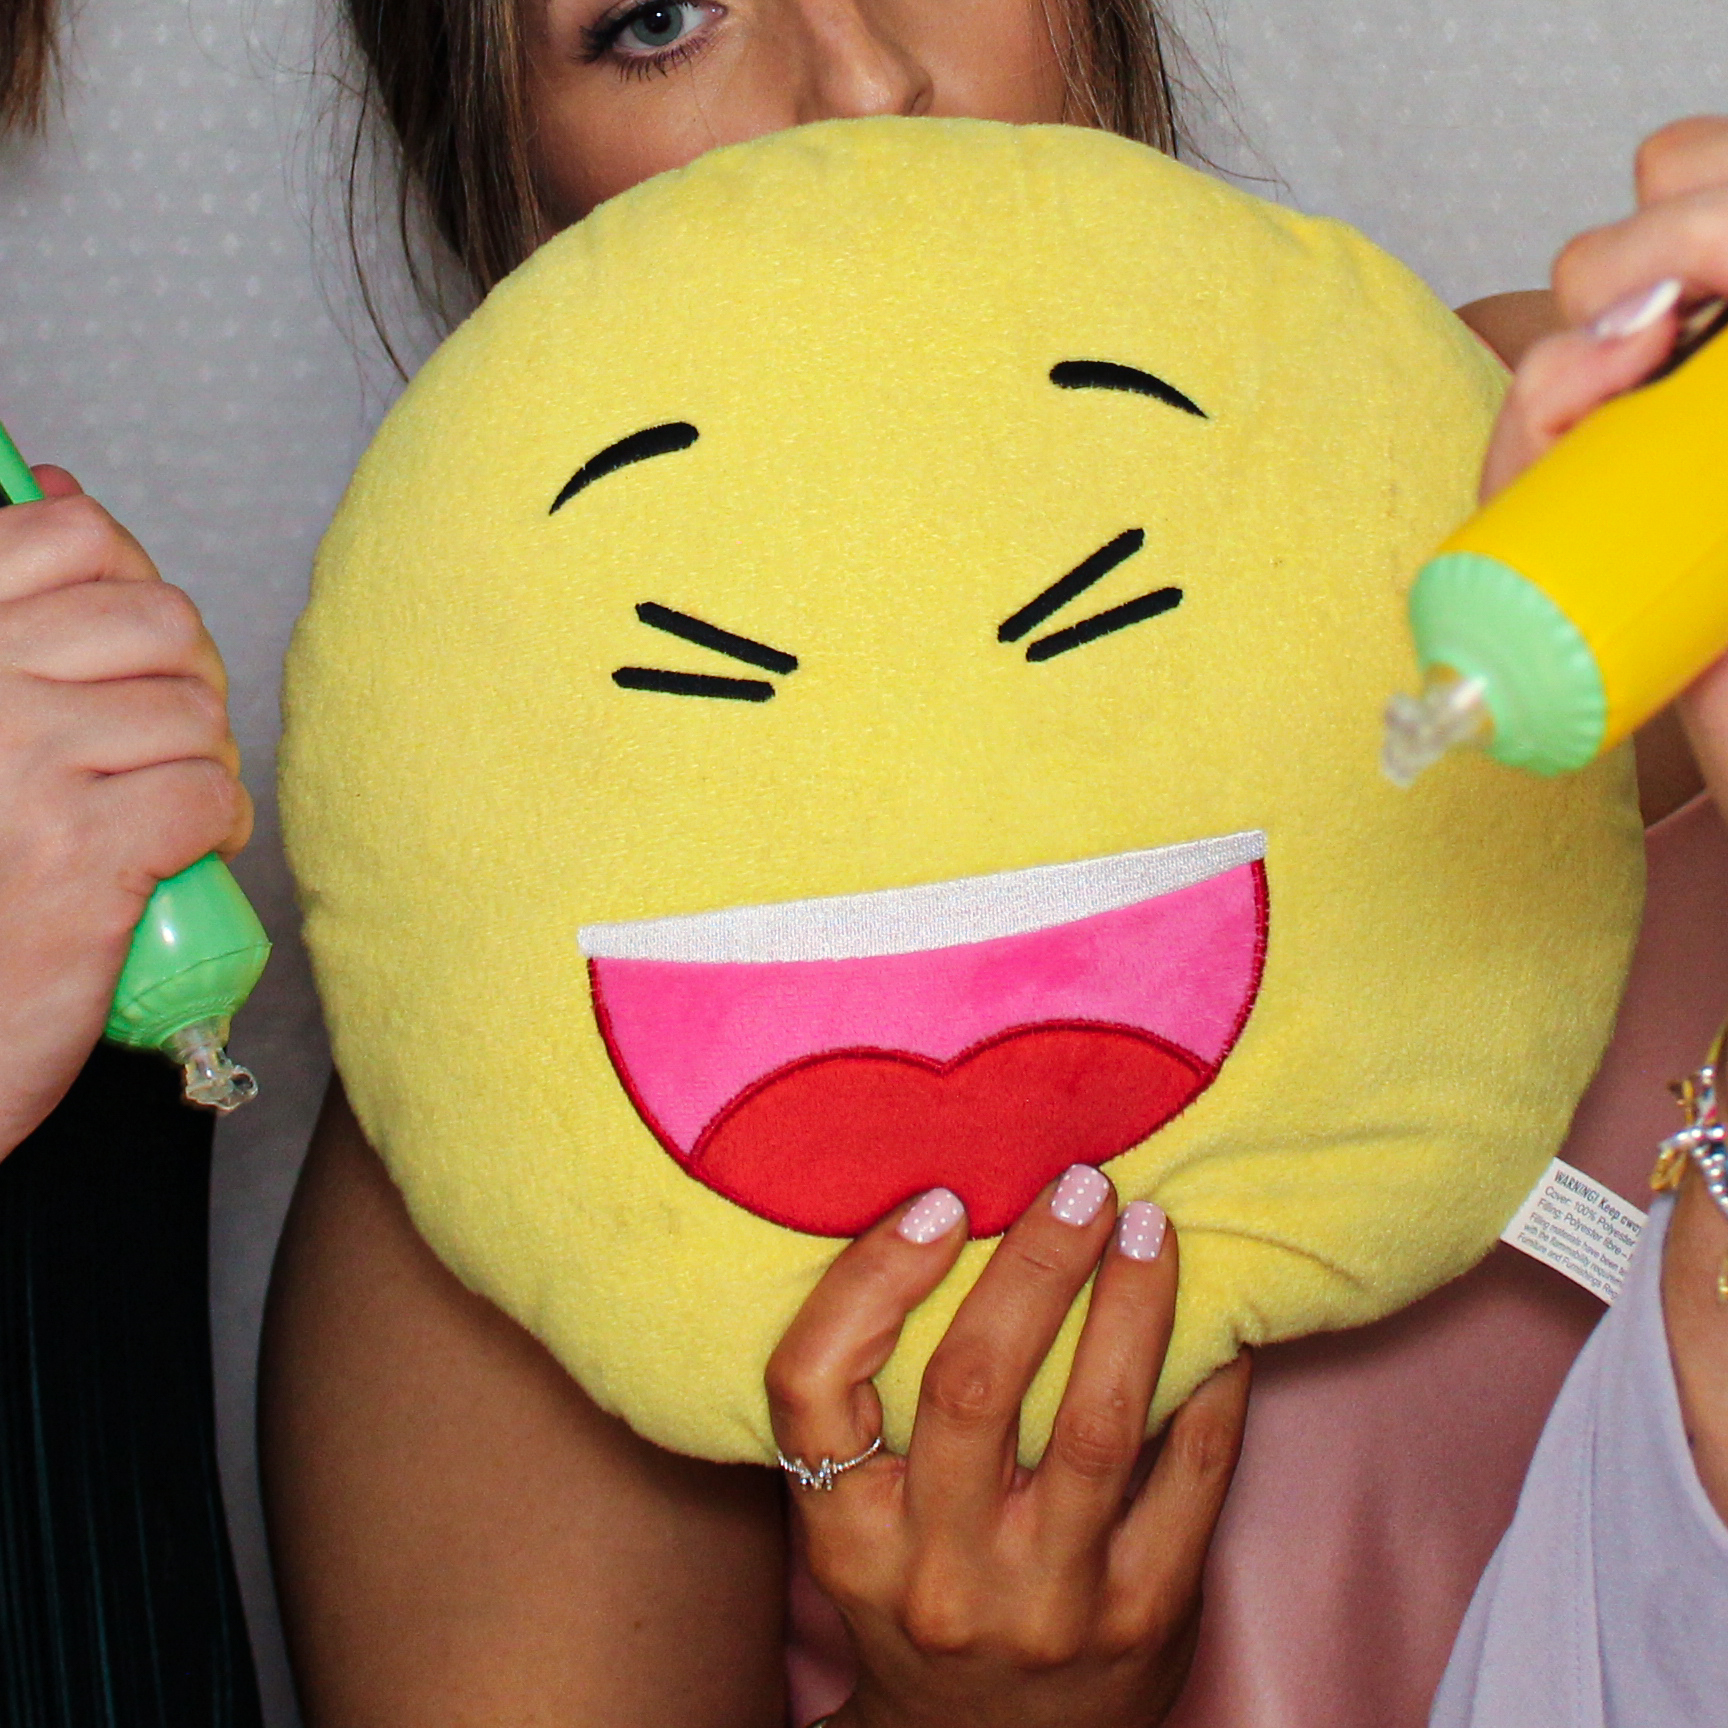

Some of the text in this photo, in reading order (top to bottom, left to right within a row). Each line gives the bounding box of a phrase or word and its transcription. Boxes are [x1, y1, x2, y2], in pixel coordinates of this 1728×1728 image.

[1555, 1170, 1599, 1203] WARNING!
[1597, 1196, 1621, 1221] Keep
[1564, 1212, 1602, 1241] Polyester
[1596, 1216, 1637, 1247] Polyester
